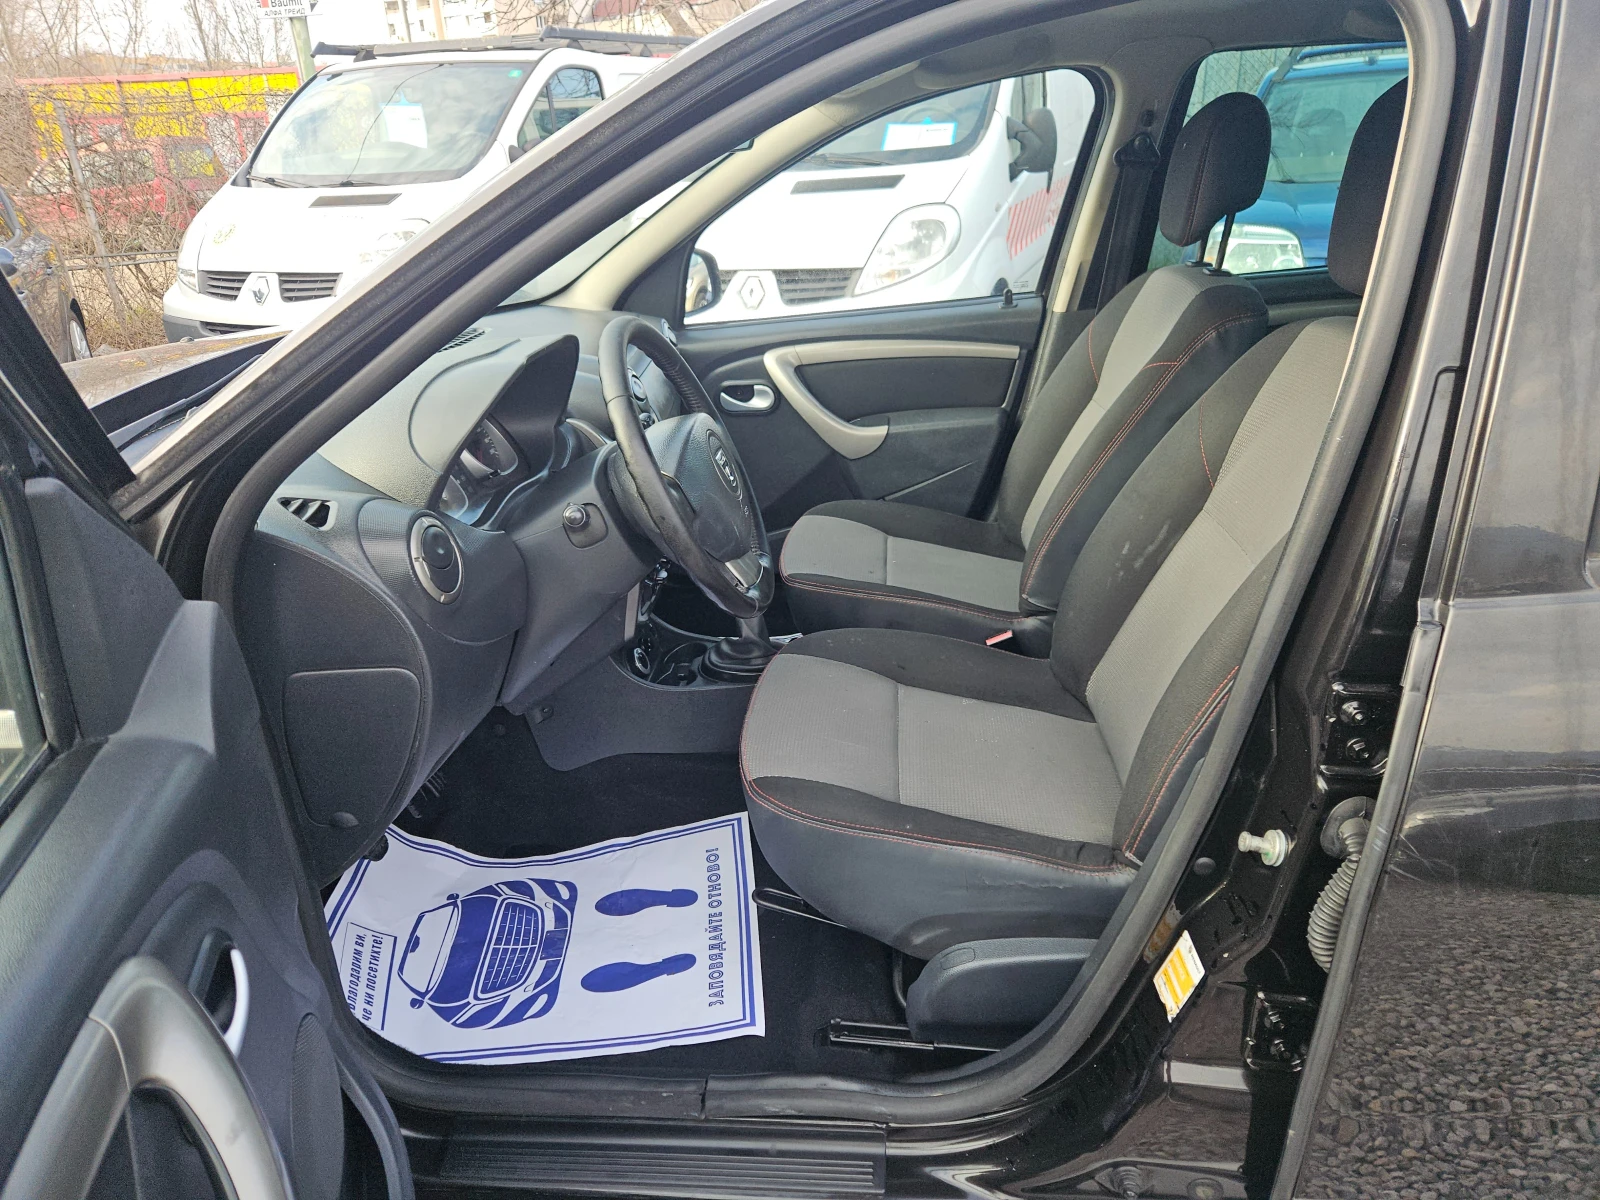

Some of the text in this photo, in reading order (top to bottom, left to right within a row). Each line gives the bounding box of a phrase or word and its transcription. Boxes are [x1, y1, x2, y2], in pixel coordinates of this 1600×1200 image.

[362, 935, 384, 1021] че ни посетихте!
[705, 847, 726, 1007] ЗАПОВЯДАЙТЕ ОТНОВО!
